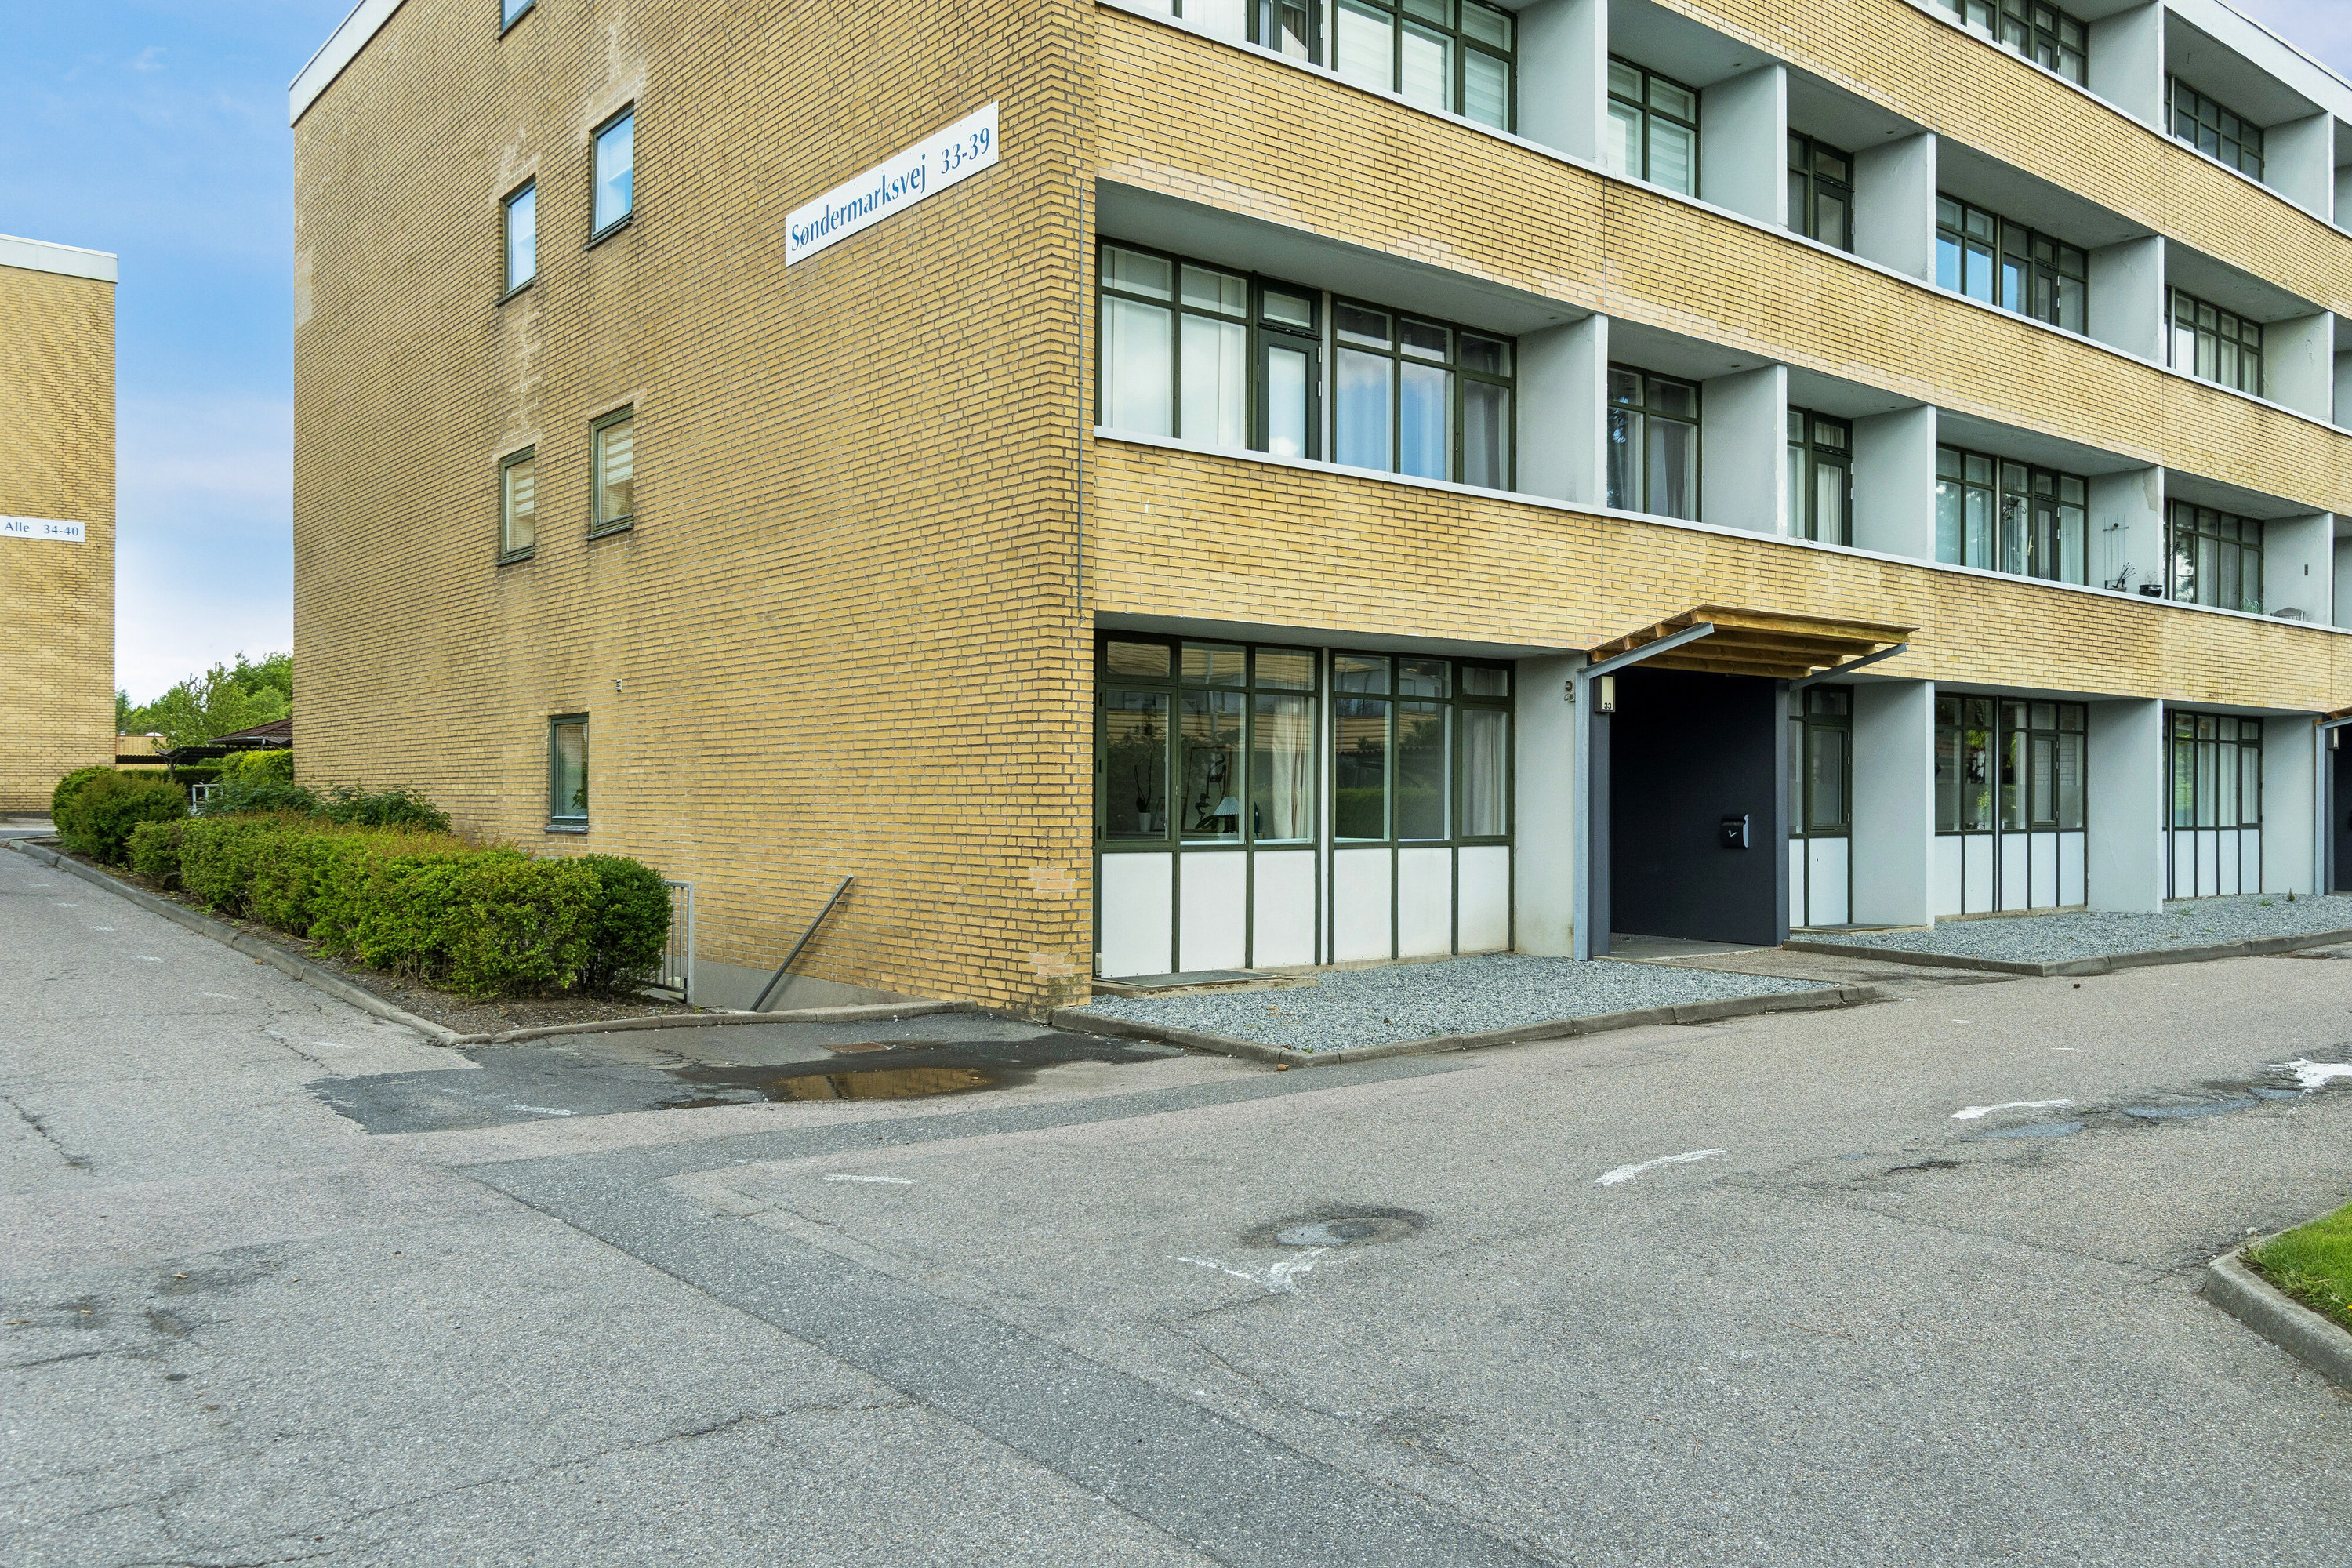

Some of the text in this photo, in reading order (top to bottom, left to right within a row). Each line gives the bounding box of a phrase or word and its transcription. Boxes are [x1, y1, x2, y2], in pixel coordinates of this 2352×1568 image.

[791, 127, 990, 252] Søndermarksvej 33-39
[5, 521, 79, 536] Alle 34-40
